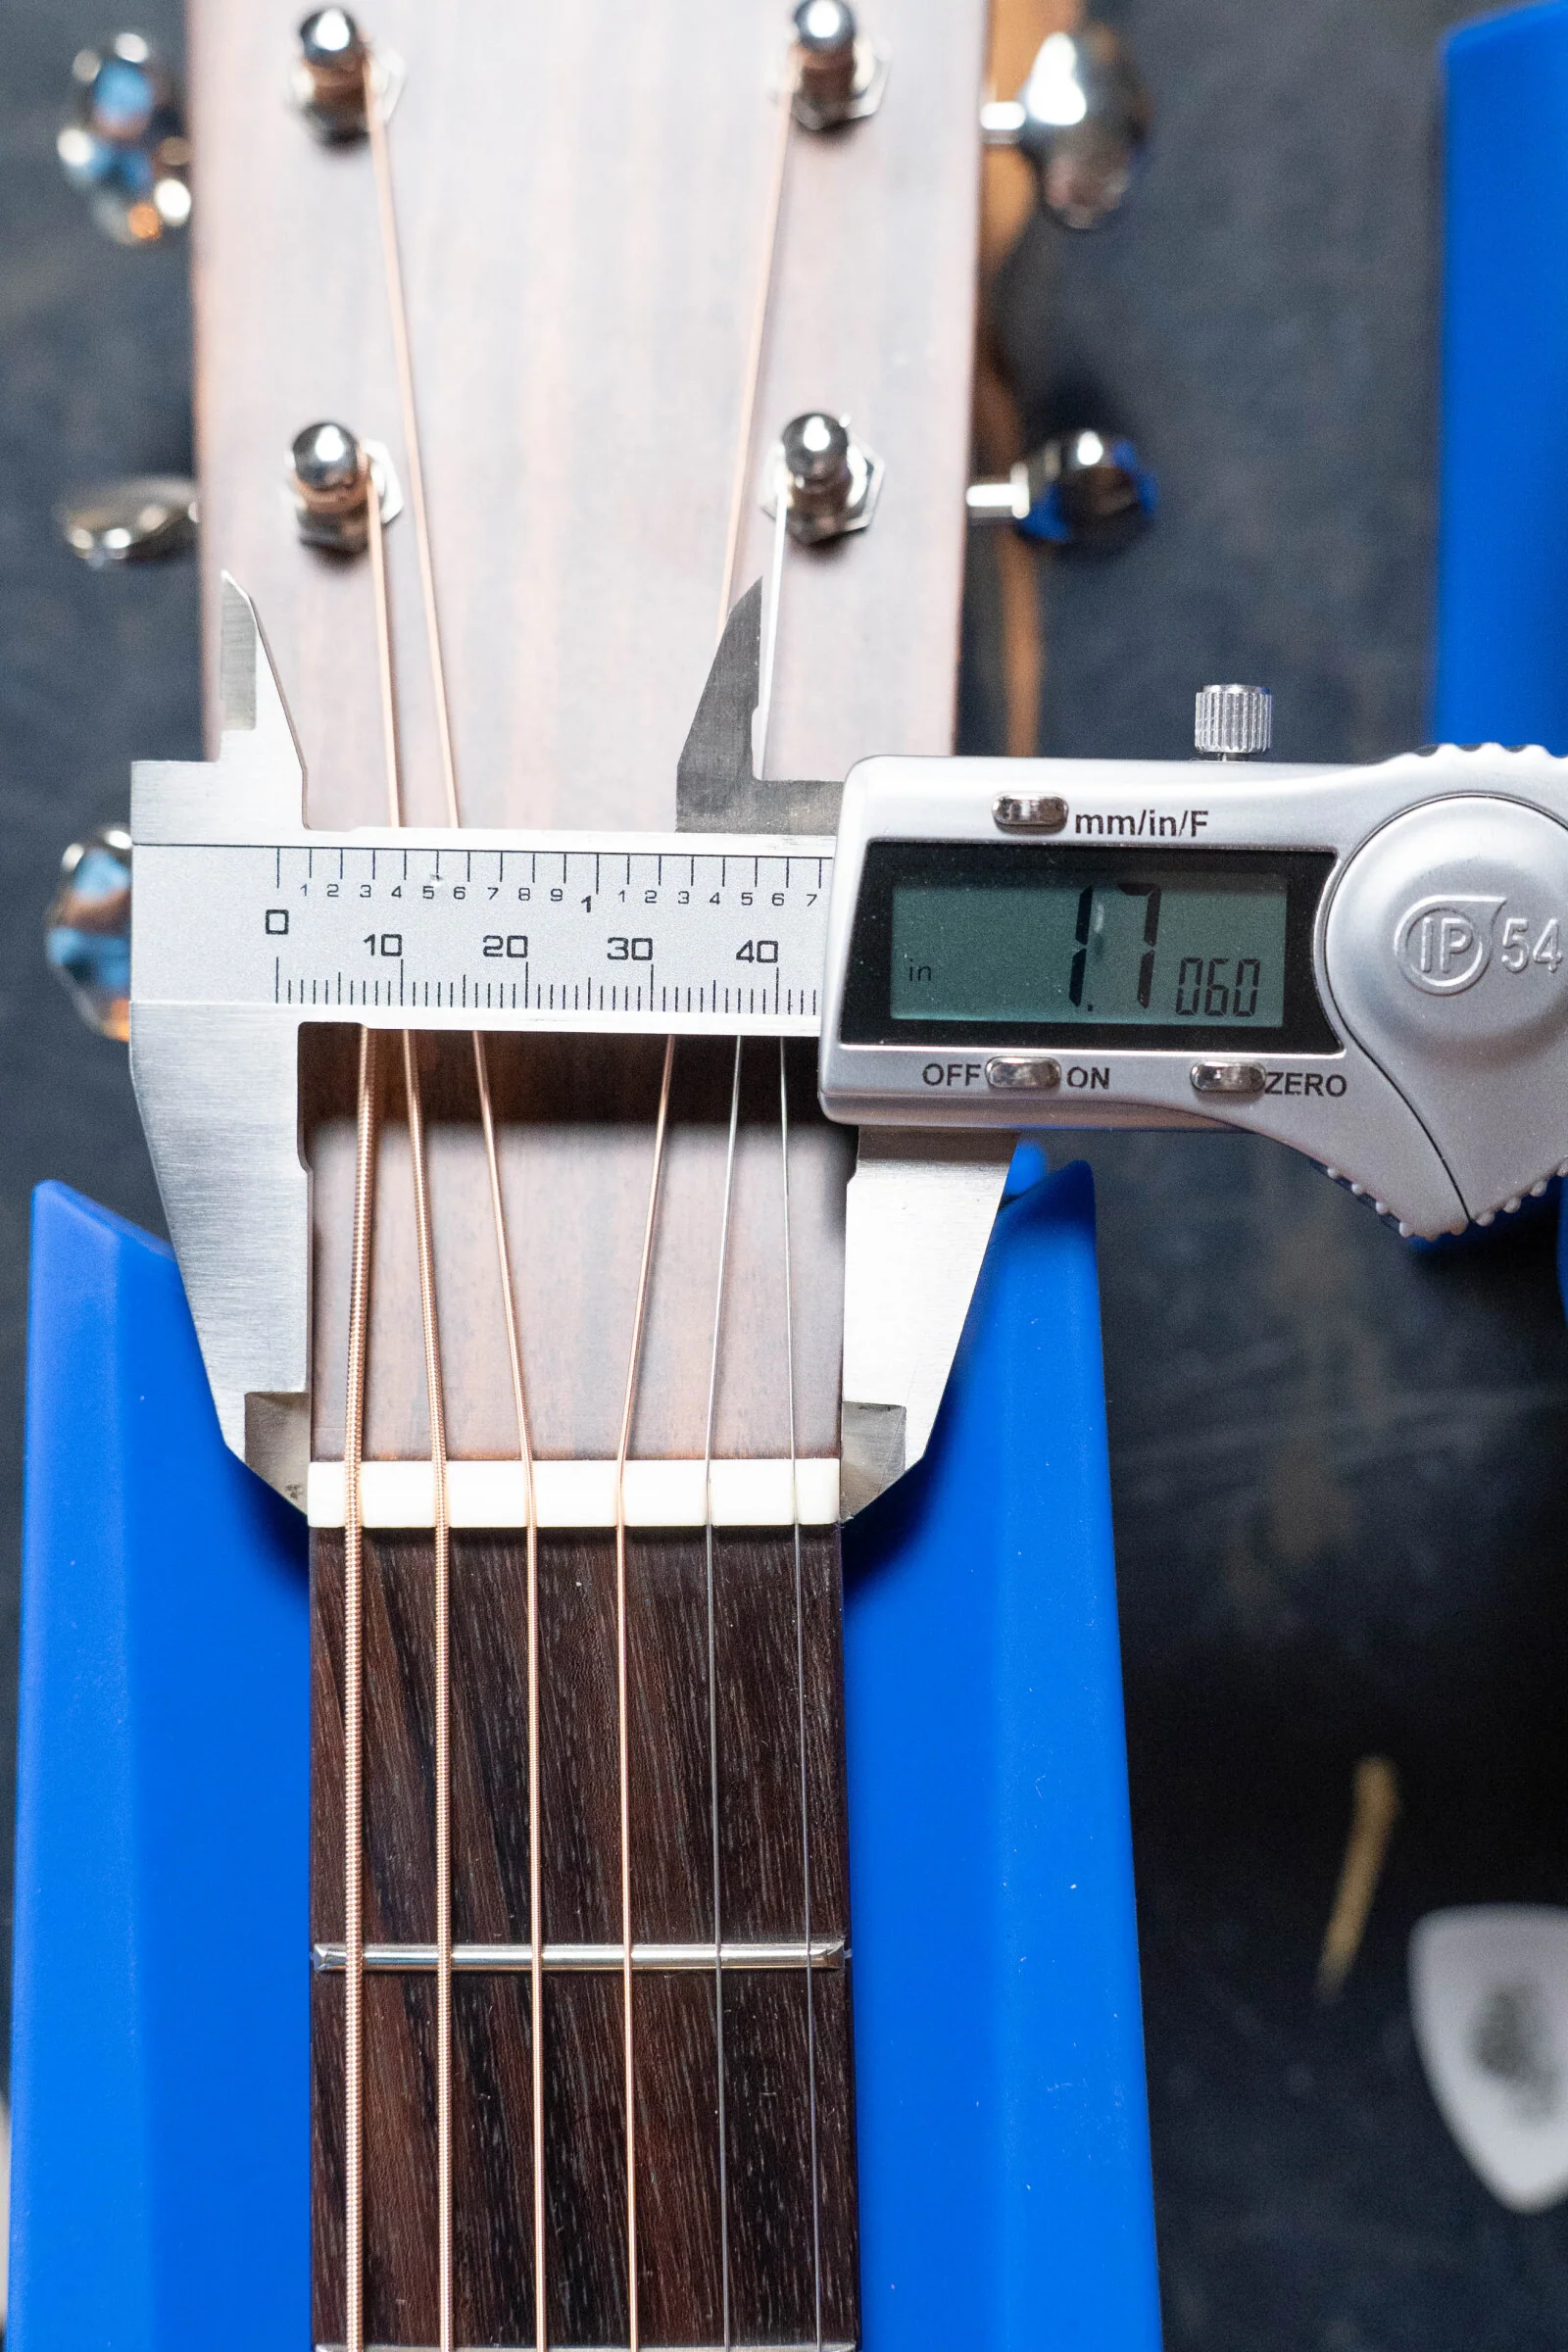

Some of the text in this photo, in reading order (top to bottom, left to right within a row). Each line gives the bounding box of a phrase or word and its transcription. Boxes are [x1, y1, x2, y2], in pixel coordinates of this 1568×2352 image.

[1075, 808, 1209, 838] mm/in/F
[299, 883, 818, 913] 1 2 3 4 5 6 7 8 9 1 1 2 3 4 5 6 7
[265, 908, 779, 963] 0 10 20 30 40
[1421, 916, 1564, 973] IP 54
[906, 958, 933, 983] in
[922, 1062, 982, 1089] OFF
[1066, 1066, 1110, 1090] ON
[1264, 1071, 1348, 1098] ZERO
